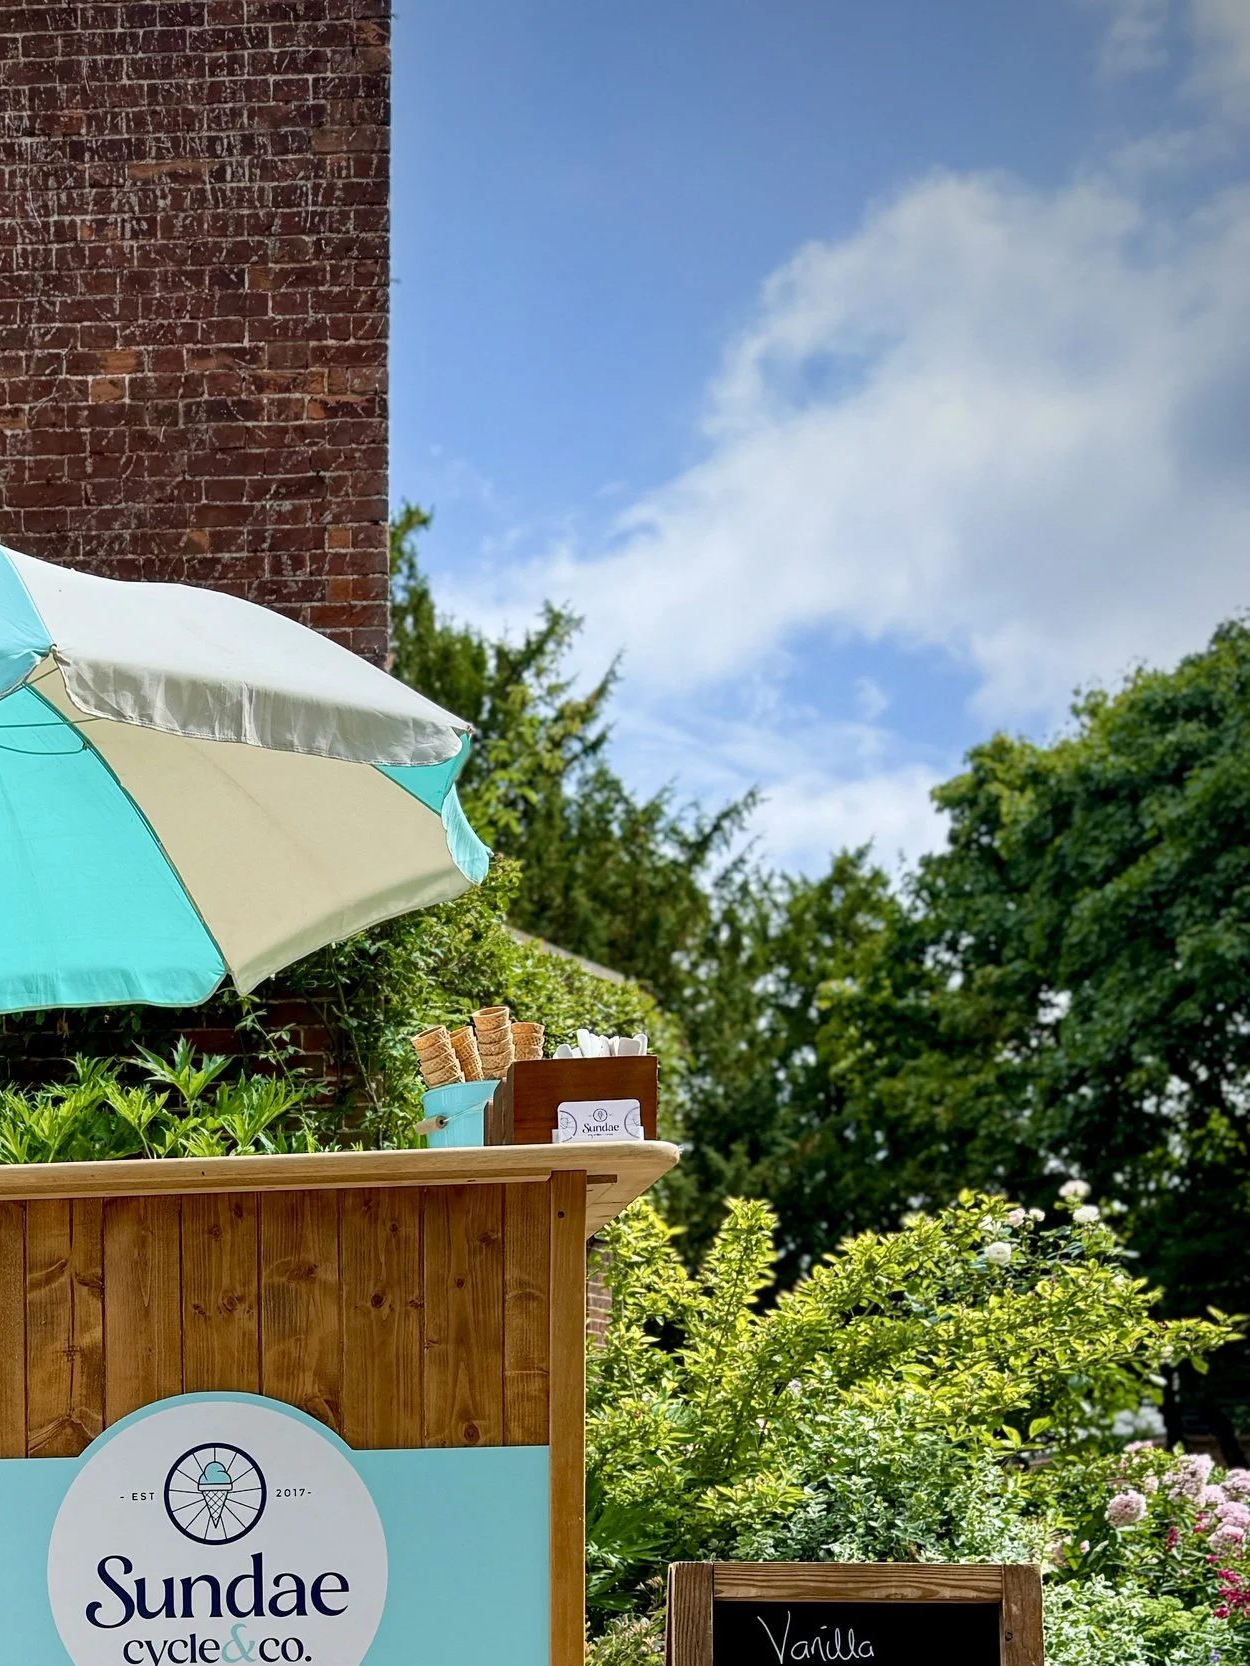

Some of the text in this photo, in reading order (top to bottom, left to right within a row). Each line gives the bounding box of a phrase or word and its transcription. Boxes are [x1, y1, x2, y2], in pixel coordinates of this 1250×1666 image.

[582, 1122, 620, 1134] Sundae
[131, 1492, 155, 1501] EST
[85, 1552, 350, 1629] Sundae
[757, 1610, 875, 1665] Vanilla
